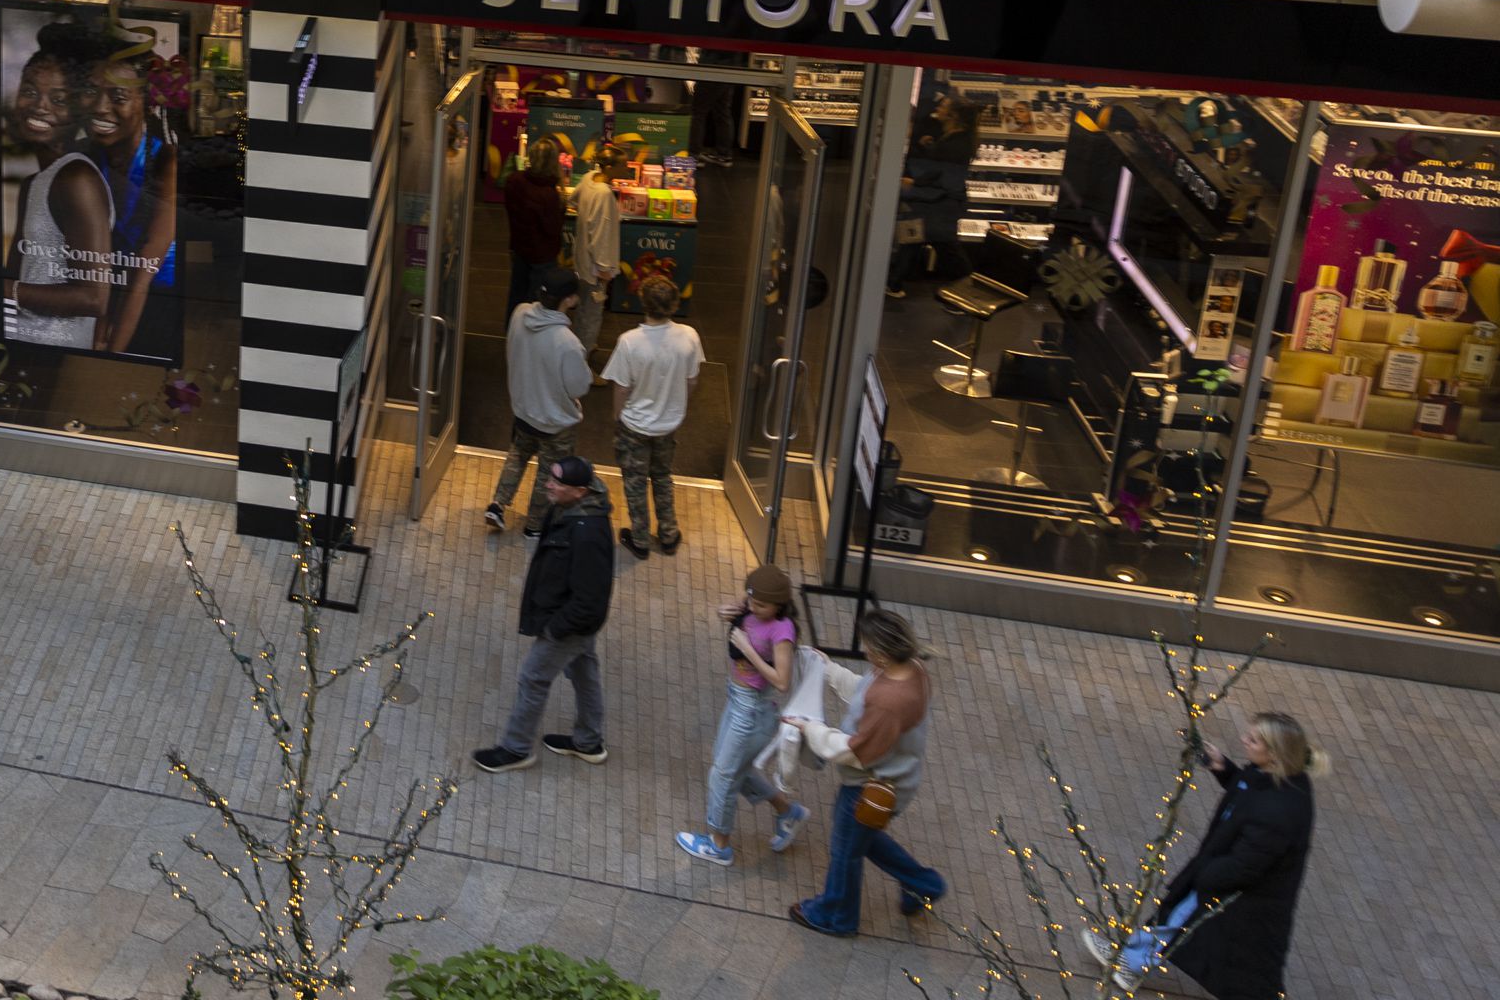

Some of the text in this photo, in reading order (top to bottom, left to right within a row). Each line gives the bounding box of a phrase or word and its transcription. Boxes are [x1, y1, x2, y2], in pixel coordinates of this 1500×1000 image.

[1434, 171, 1474, 188] best
[1405, 187, 1429, 201] of
[1427, 189, 1459, 204] the
[17, 239, 160, 273] Give Something
[47, 261, 128, 286] Beautiful
[878, 526, 911, 542] 123
